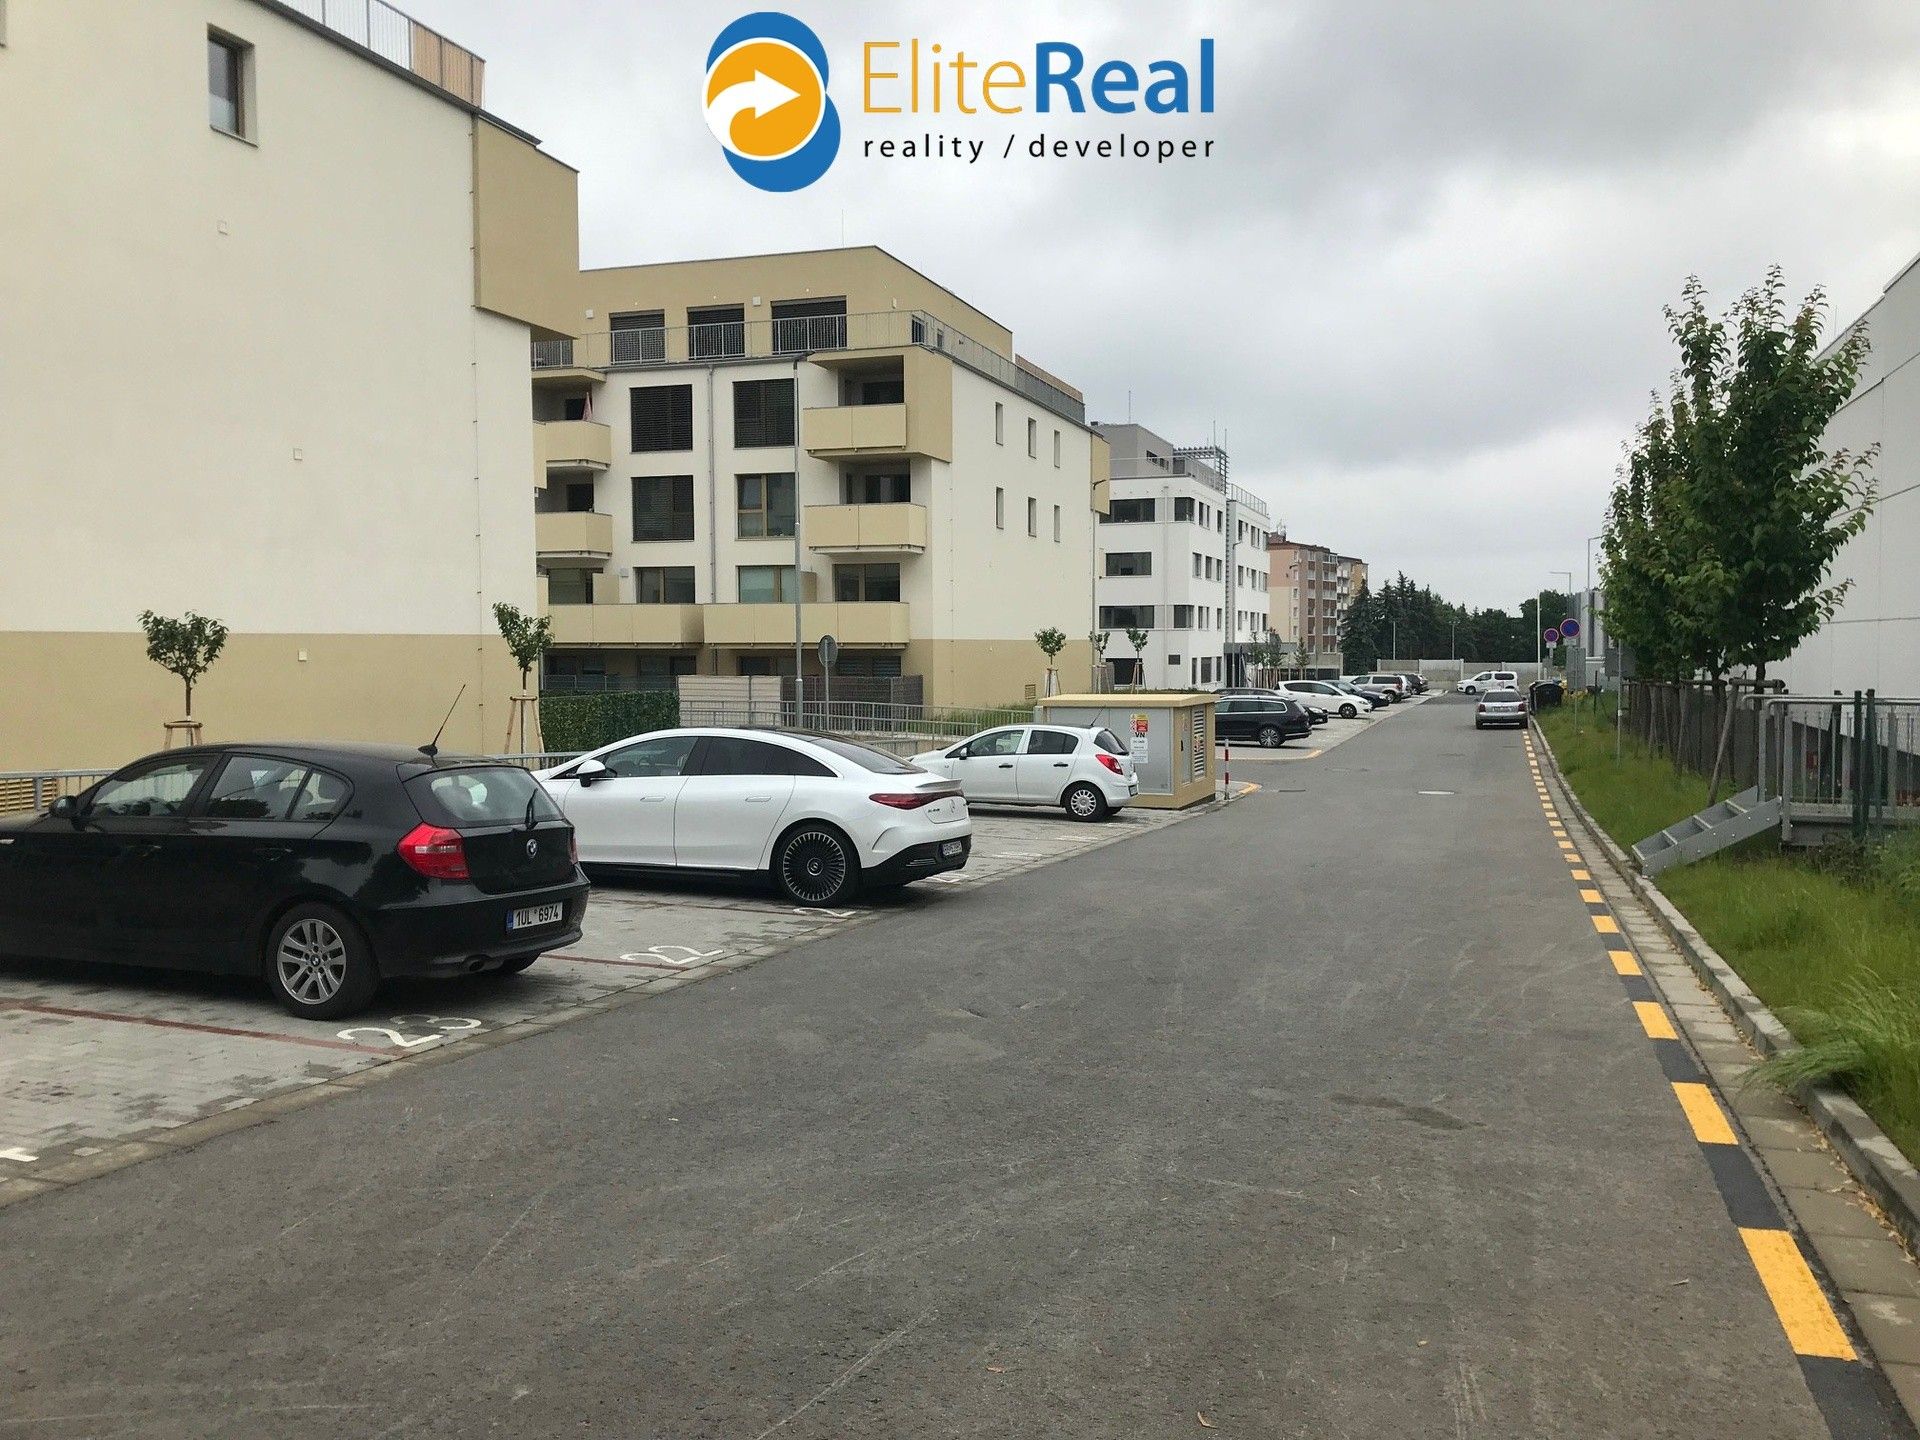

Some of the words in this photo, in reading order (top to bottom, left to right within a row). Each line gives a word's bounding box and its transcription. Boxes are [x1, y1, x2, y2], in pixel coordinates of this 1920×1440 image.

[516, 910, 533, 927] 1UL
[538, 904, 559, 922] 6974
[620, 945, 724, 965] 22
[336, 1013, 482, 1048] 23
